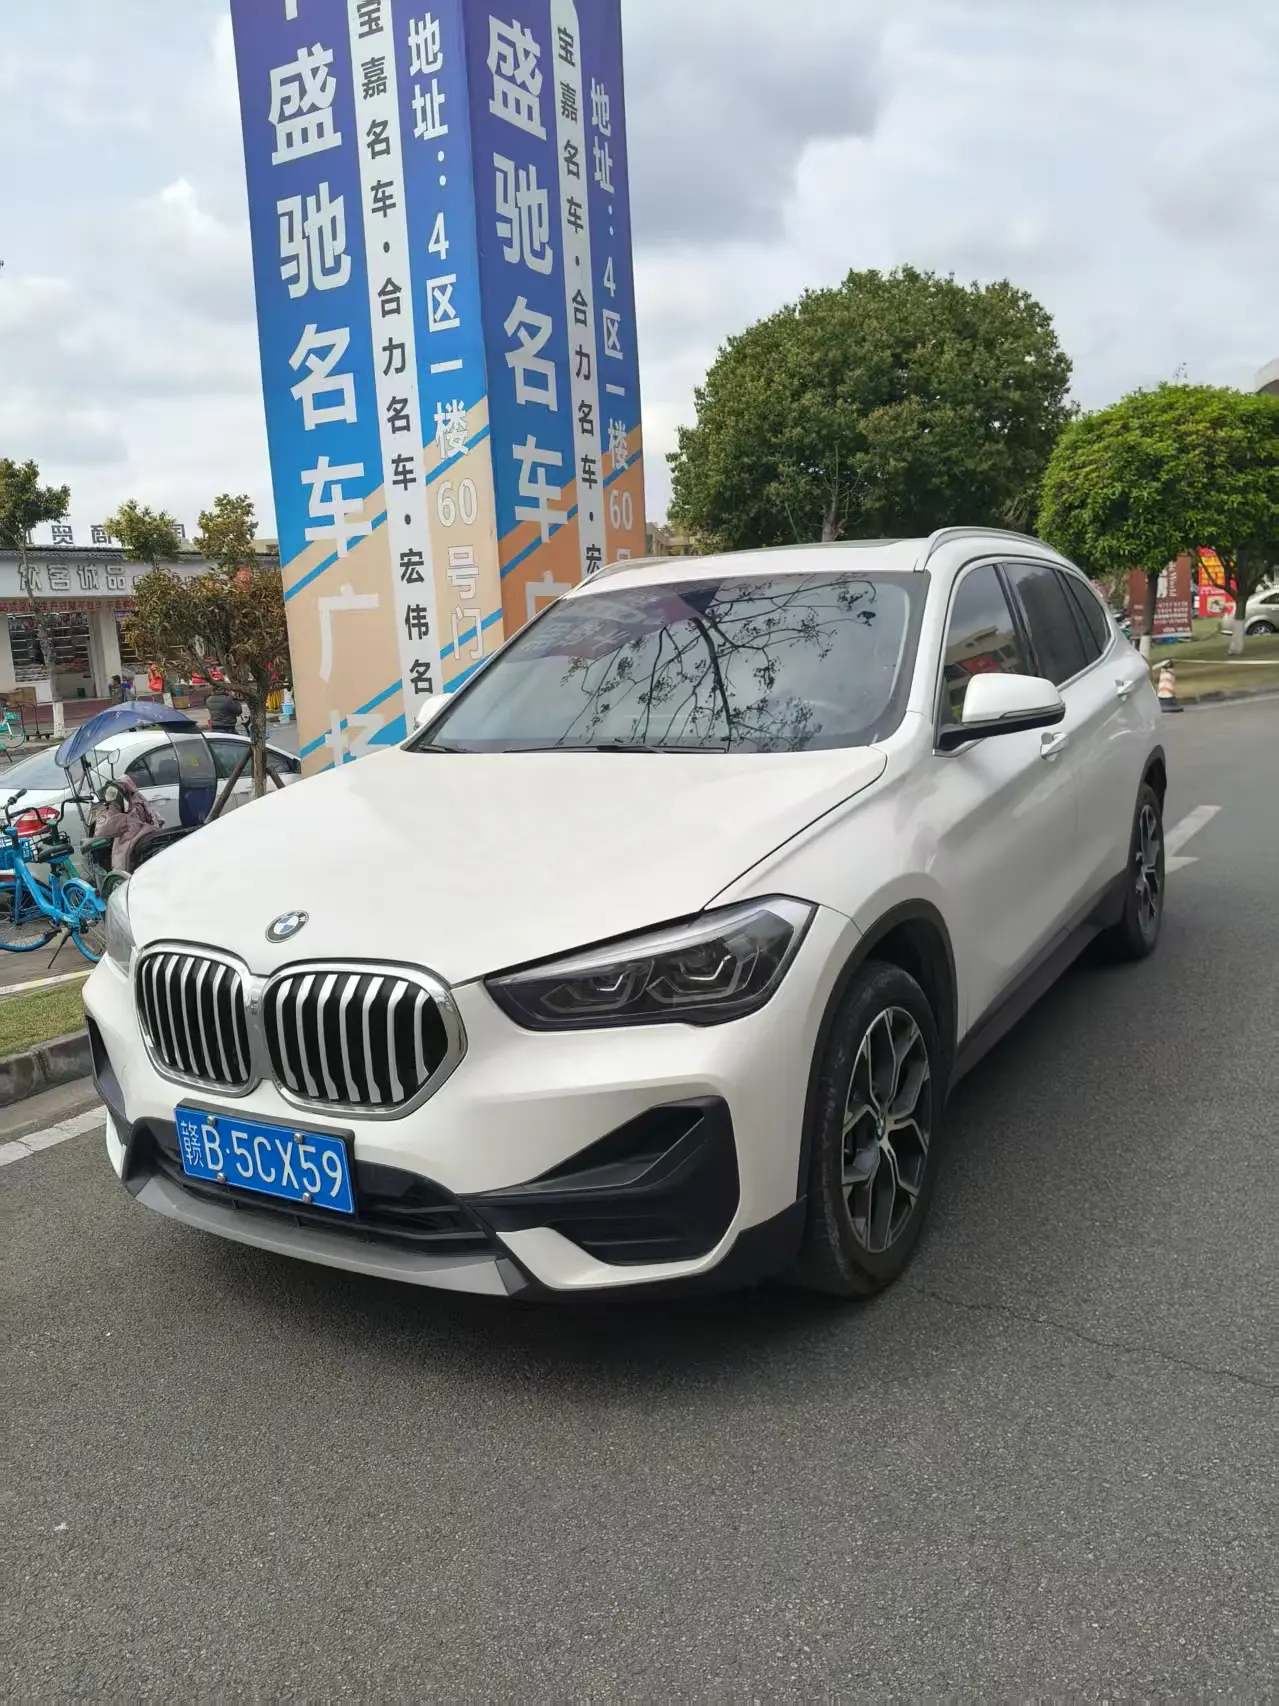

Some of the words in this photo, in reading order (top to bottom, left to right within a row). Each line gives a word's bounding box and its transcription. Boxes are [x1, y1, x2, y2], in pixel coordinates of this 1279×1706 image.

[268, 0, 394, 768] 盛驰名车广场
[591, 78, 633, 562] 地址：4区一楼60
[181, 1121, 343, 1197] 赣B·5CX59
